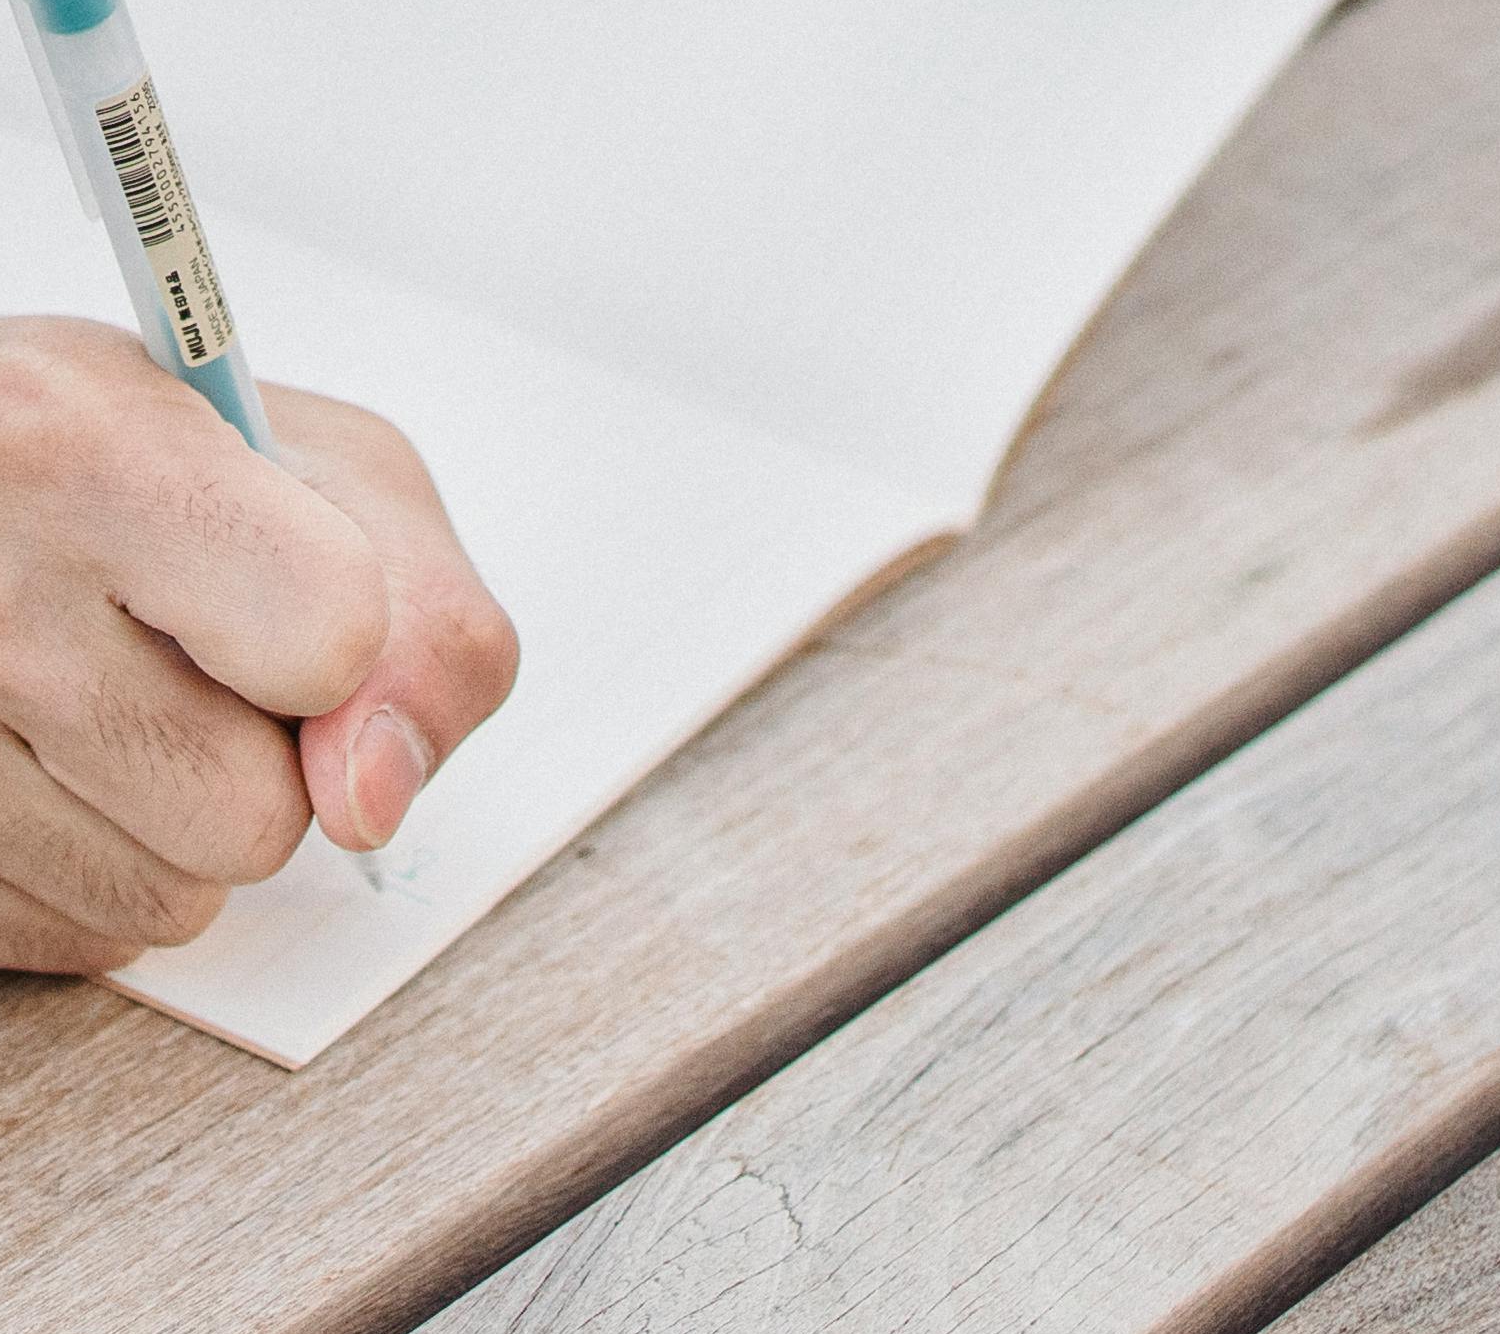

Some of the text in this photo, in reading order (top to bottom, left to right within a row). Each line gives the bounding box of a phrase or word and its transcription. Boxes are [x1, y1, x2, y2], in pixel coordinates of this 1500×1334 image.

[129, 92, 185, 233] 4550002794156
[181, 322, 208, 361] MUJI
[189, 257, 226, 348] MADE IN JAPAN
